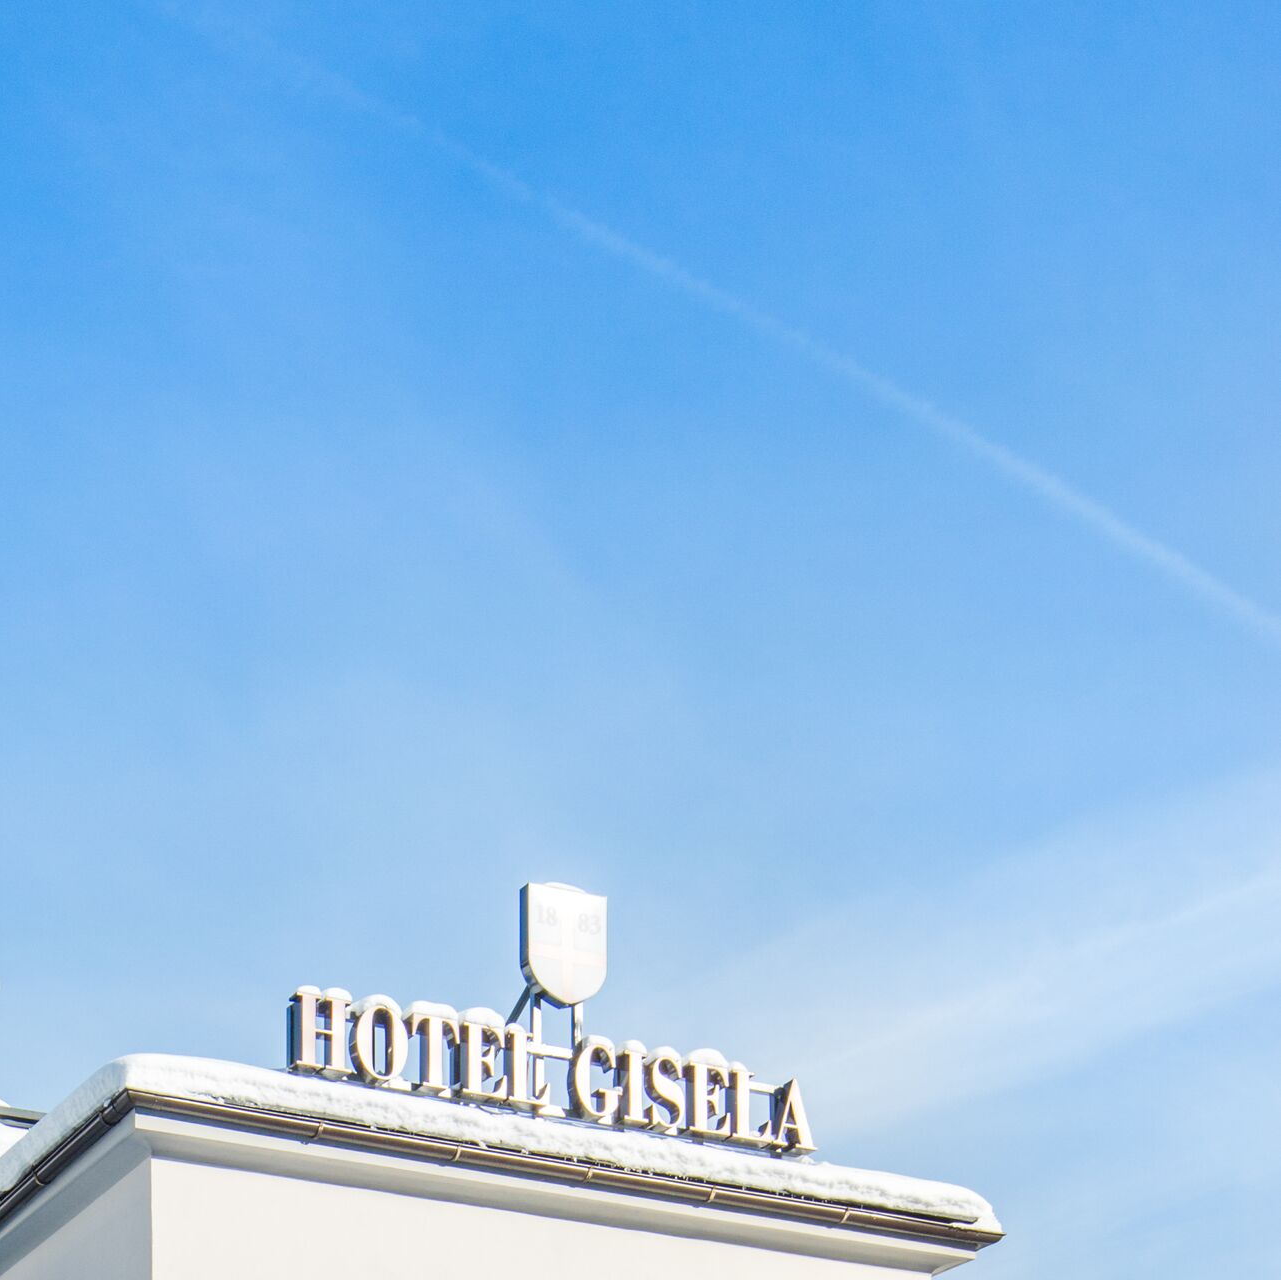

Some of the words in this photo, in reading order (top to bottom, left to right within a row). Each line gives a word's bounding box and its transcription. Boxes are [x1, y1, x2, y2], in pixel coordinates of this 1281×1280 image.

[534, 903, 558, 927] 18
[577, 912, 602, 936] 83
[288, 990, 550, 1107] HOTEL
[568, 1042, 817, 1154] GISELA
